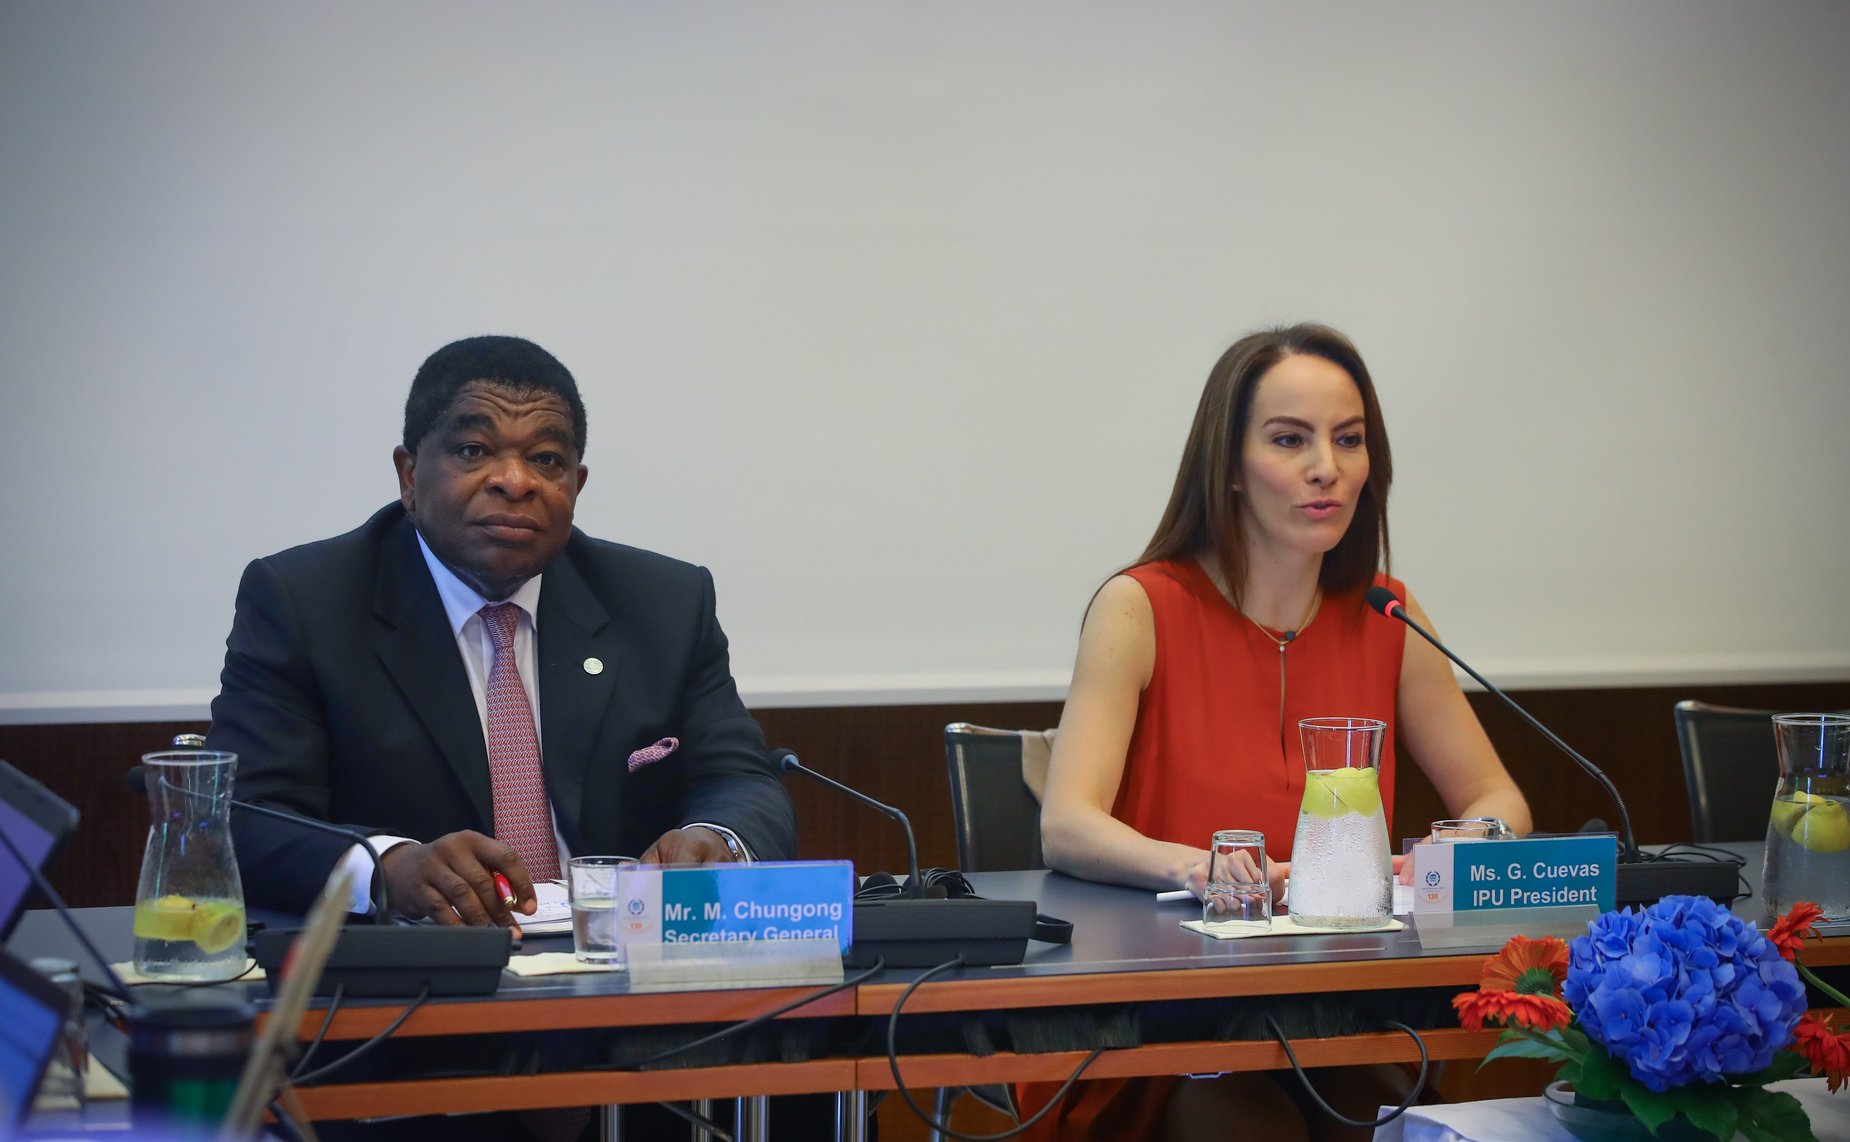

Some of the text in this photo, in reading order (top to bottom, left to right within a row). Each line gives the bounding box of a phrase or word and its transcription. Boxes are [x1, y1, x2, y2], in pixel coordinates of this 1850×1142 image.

[1470, 862, 1600, 881] Ms. G. Cuevas
[1473, 885, 1597, 906] IPU President
[664, 900, 842, 921] Mr. M. Chungong
[664, 925, 839, 944] Secretary General
